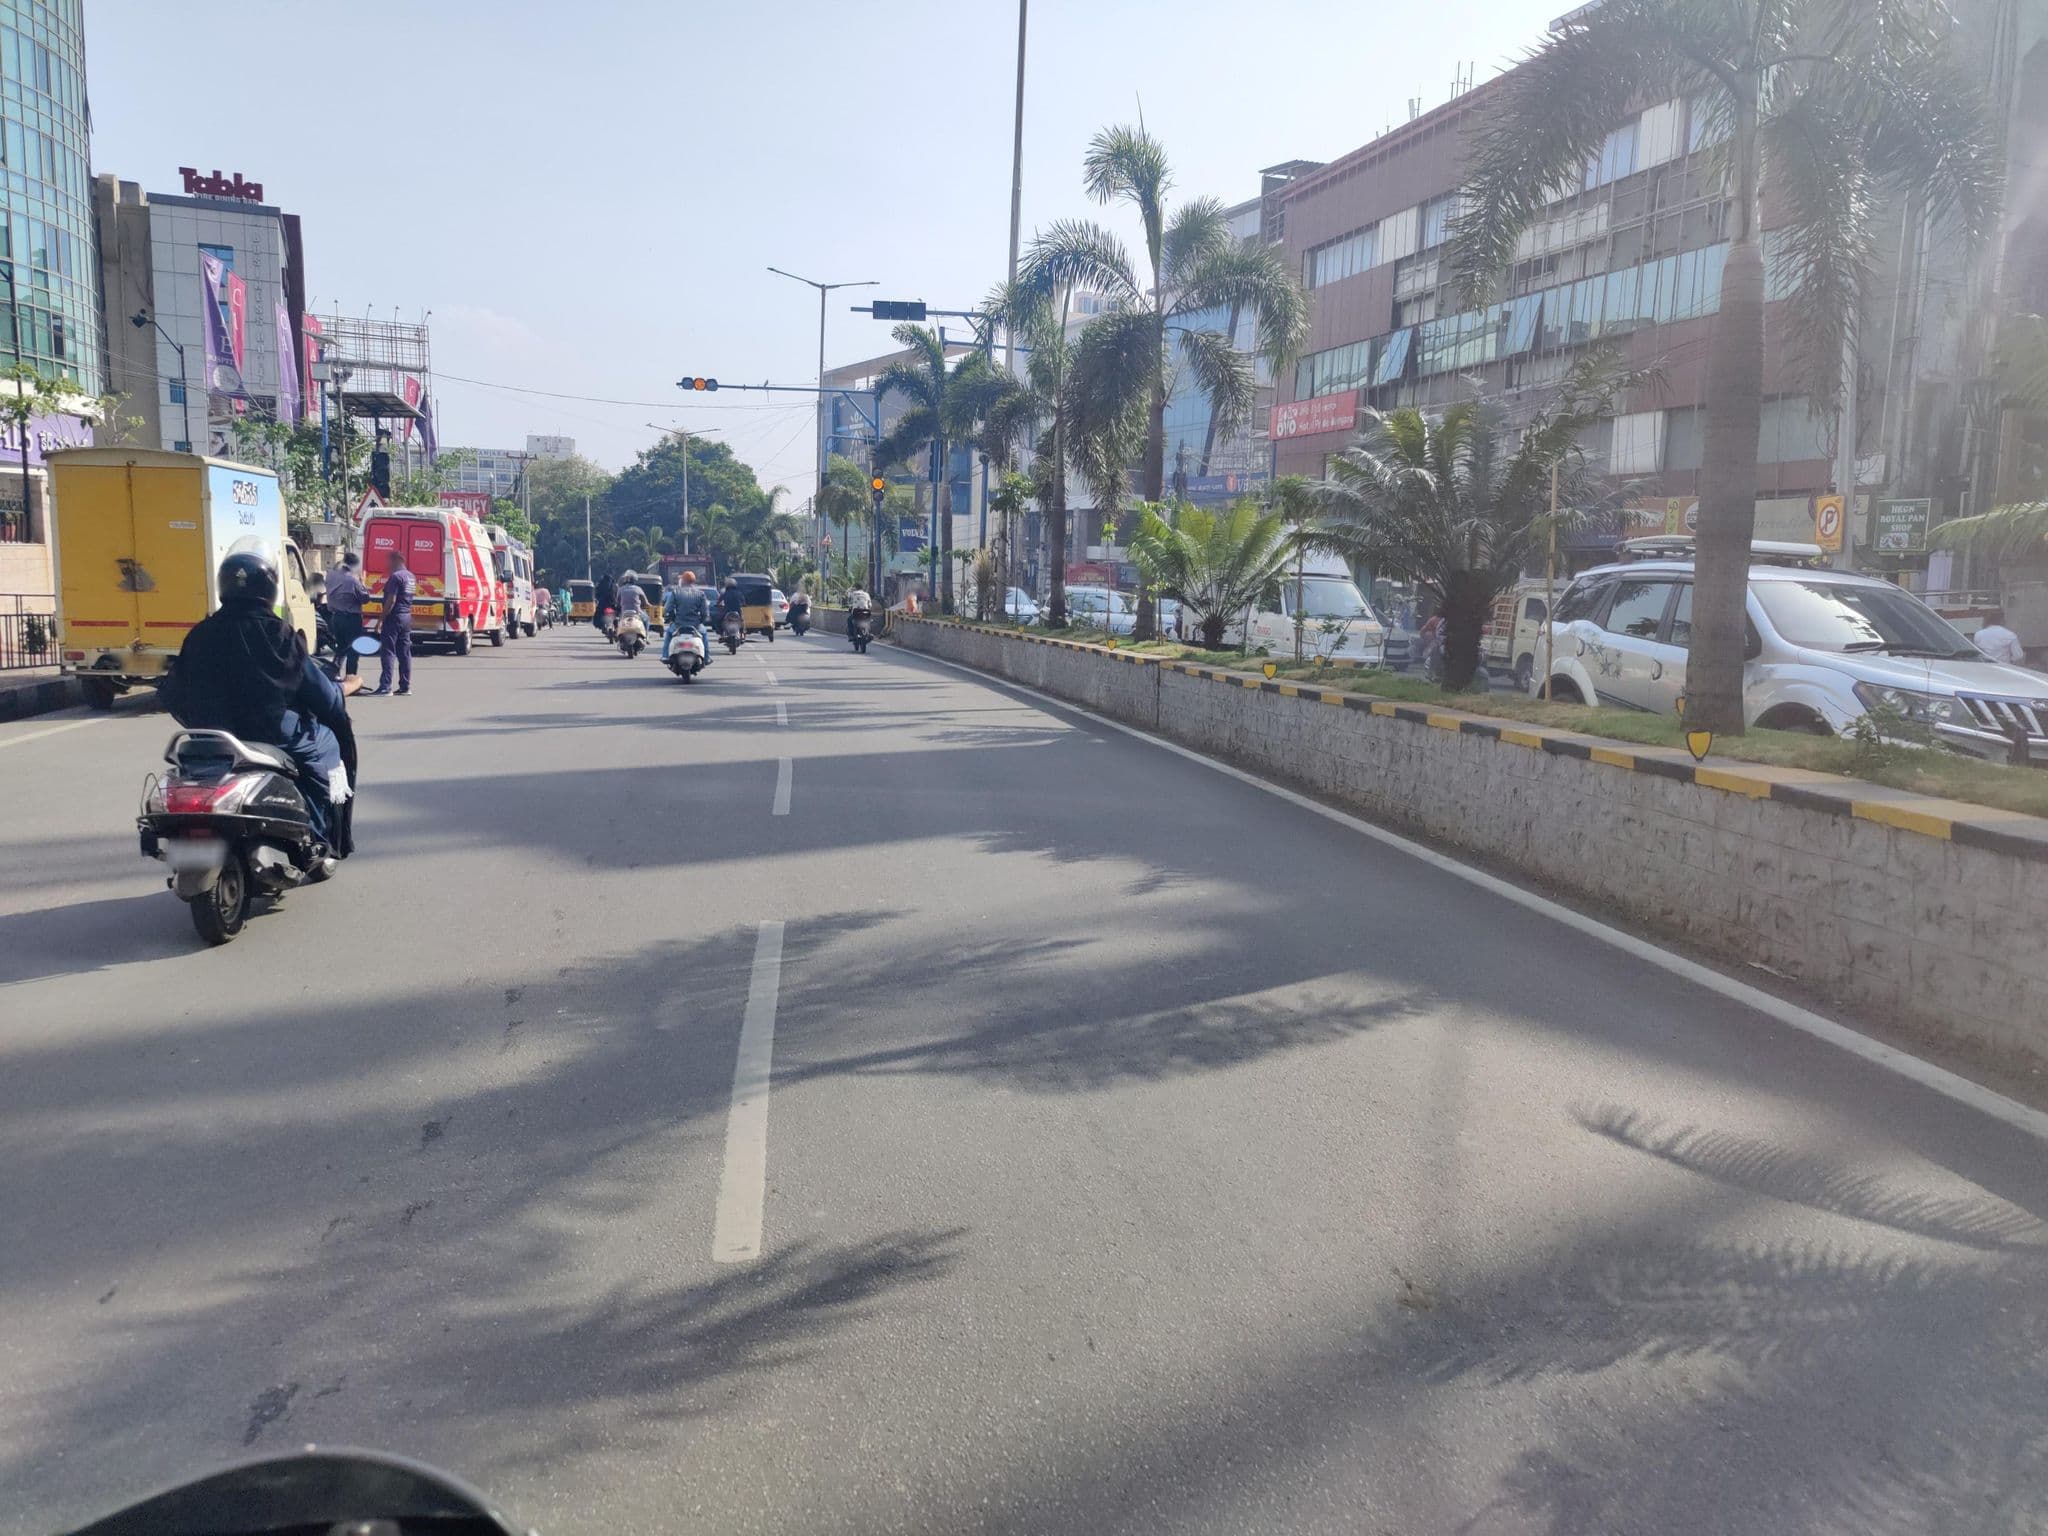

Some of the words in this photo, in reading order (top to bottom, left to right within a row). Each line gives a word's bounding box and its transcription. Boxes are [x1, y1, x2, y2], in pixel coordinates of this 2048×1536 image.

[179, 167, 263, 202] Tabla
[1908, 514, 1925, 522] PAN
[1892, 524, 1912, 532] SHOP
